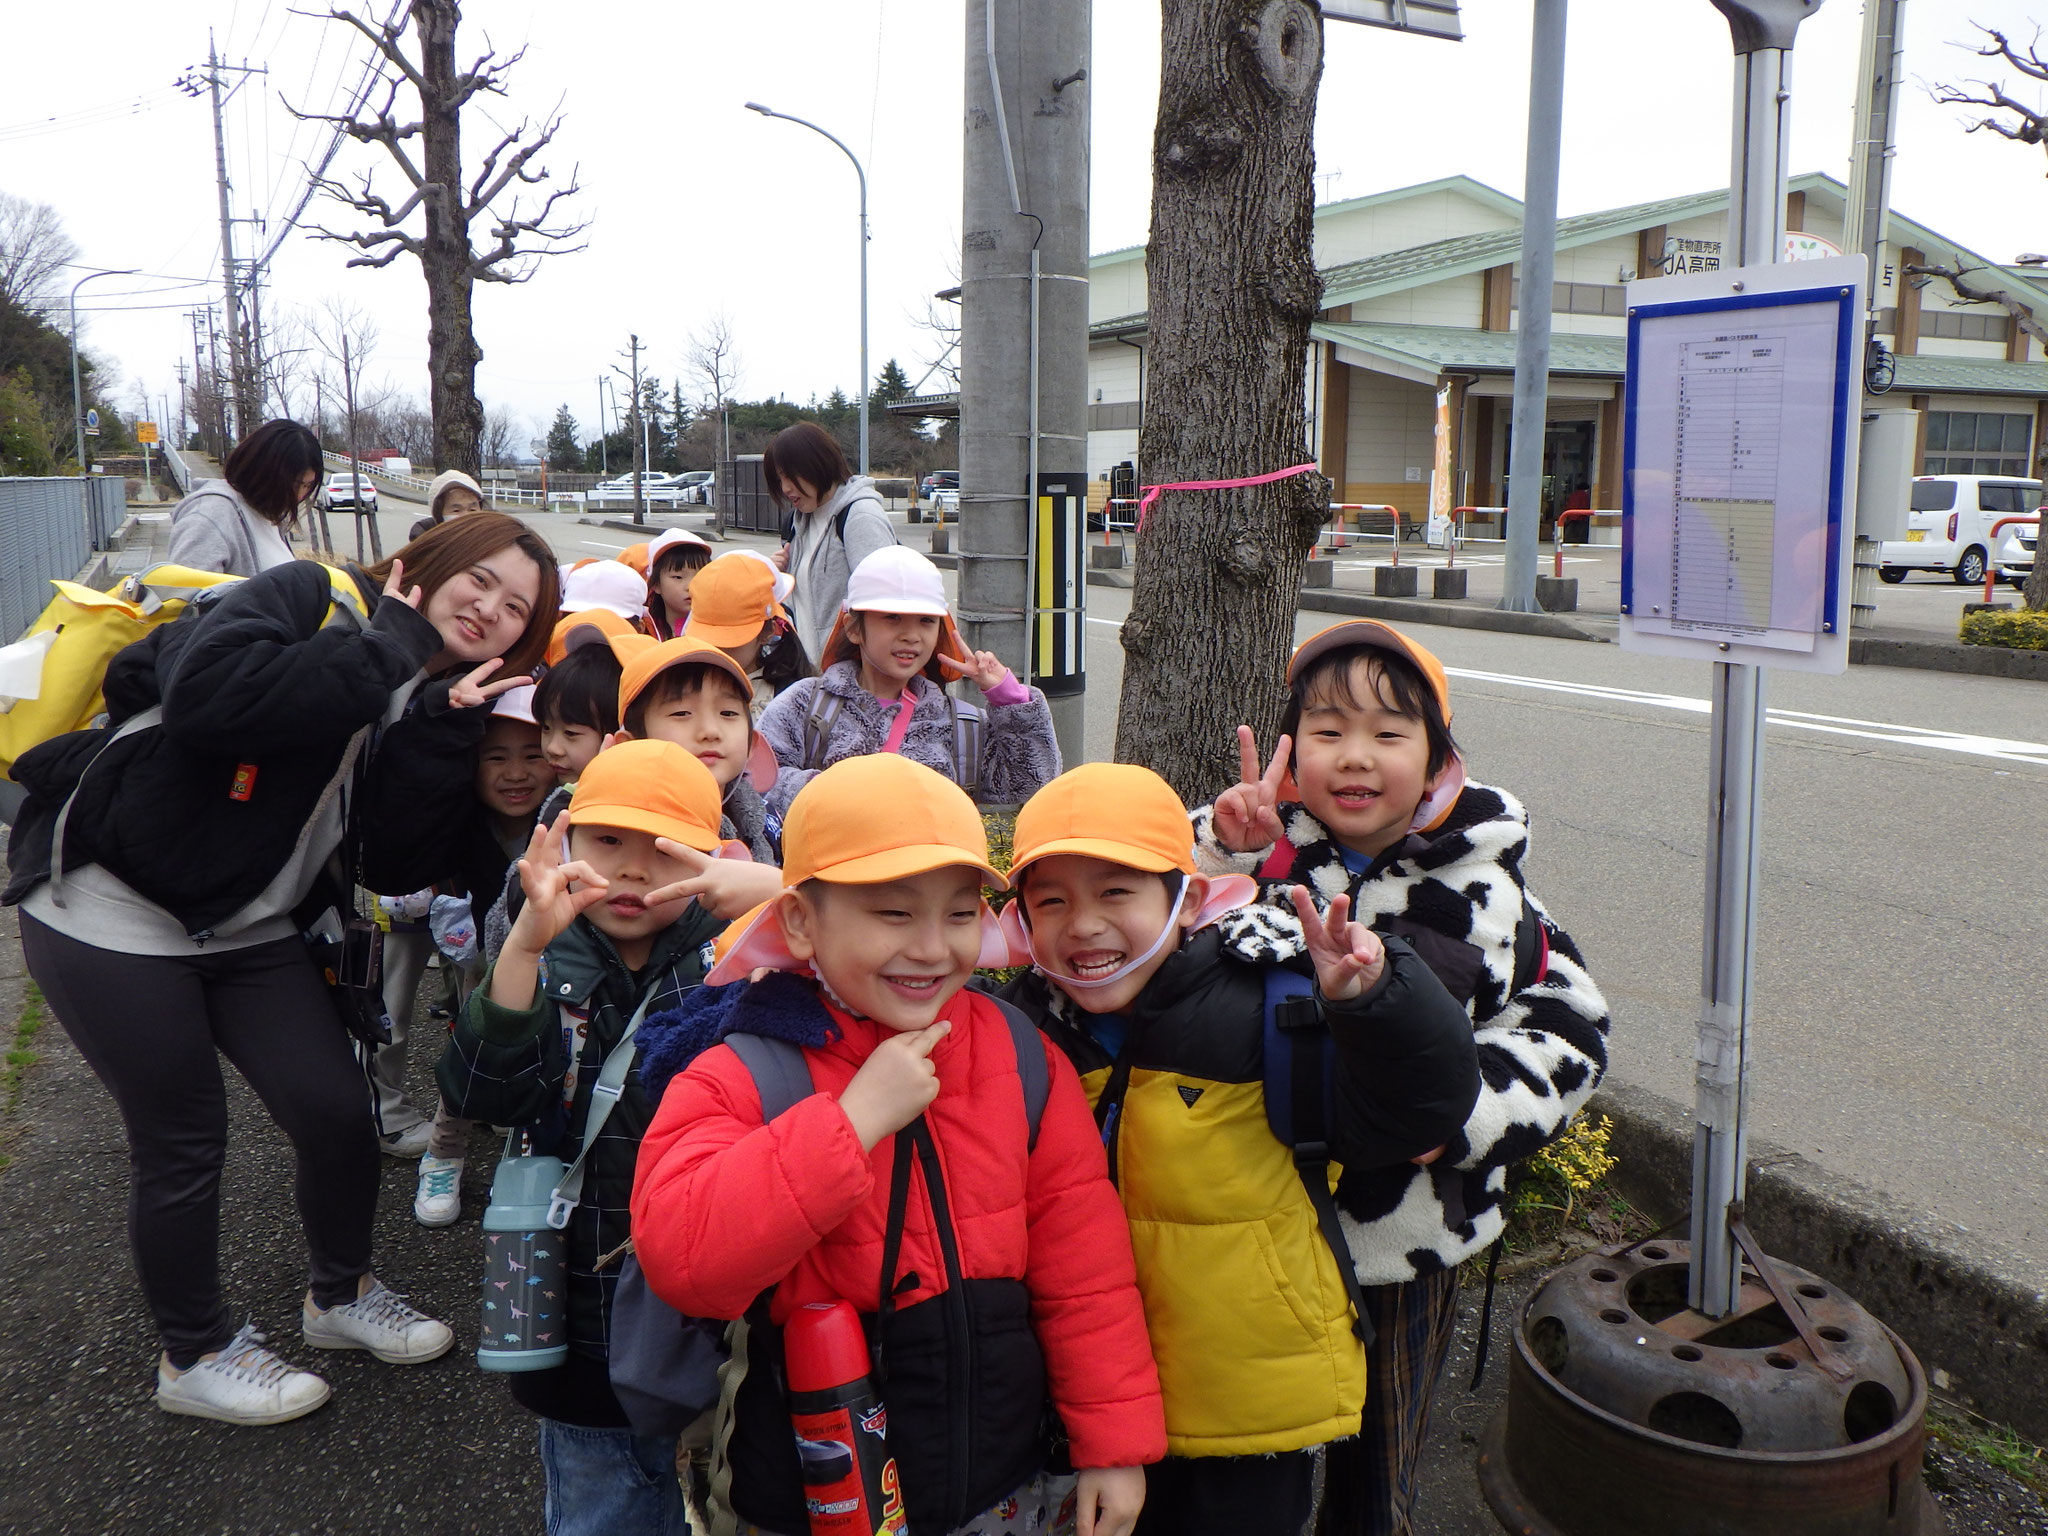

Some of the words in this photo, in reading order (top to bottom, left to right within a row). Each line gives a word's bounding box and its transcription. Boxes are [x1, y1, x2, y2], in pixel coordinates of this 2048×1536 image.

[1667, 237, 1722, 255] 産物直売所
[1664, 254, 1720, 275] JA高岡
